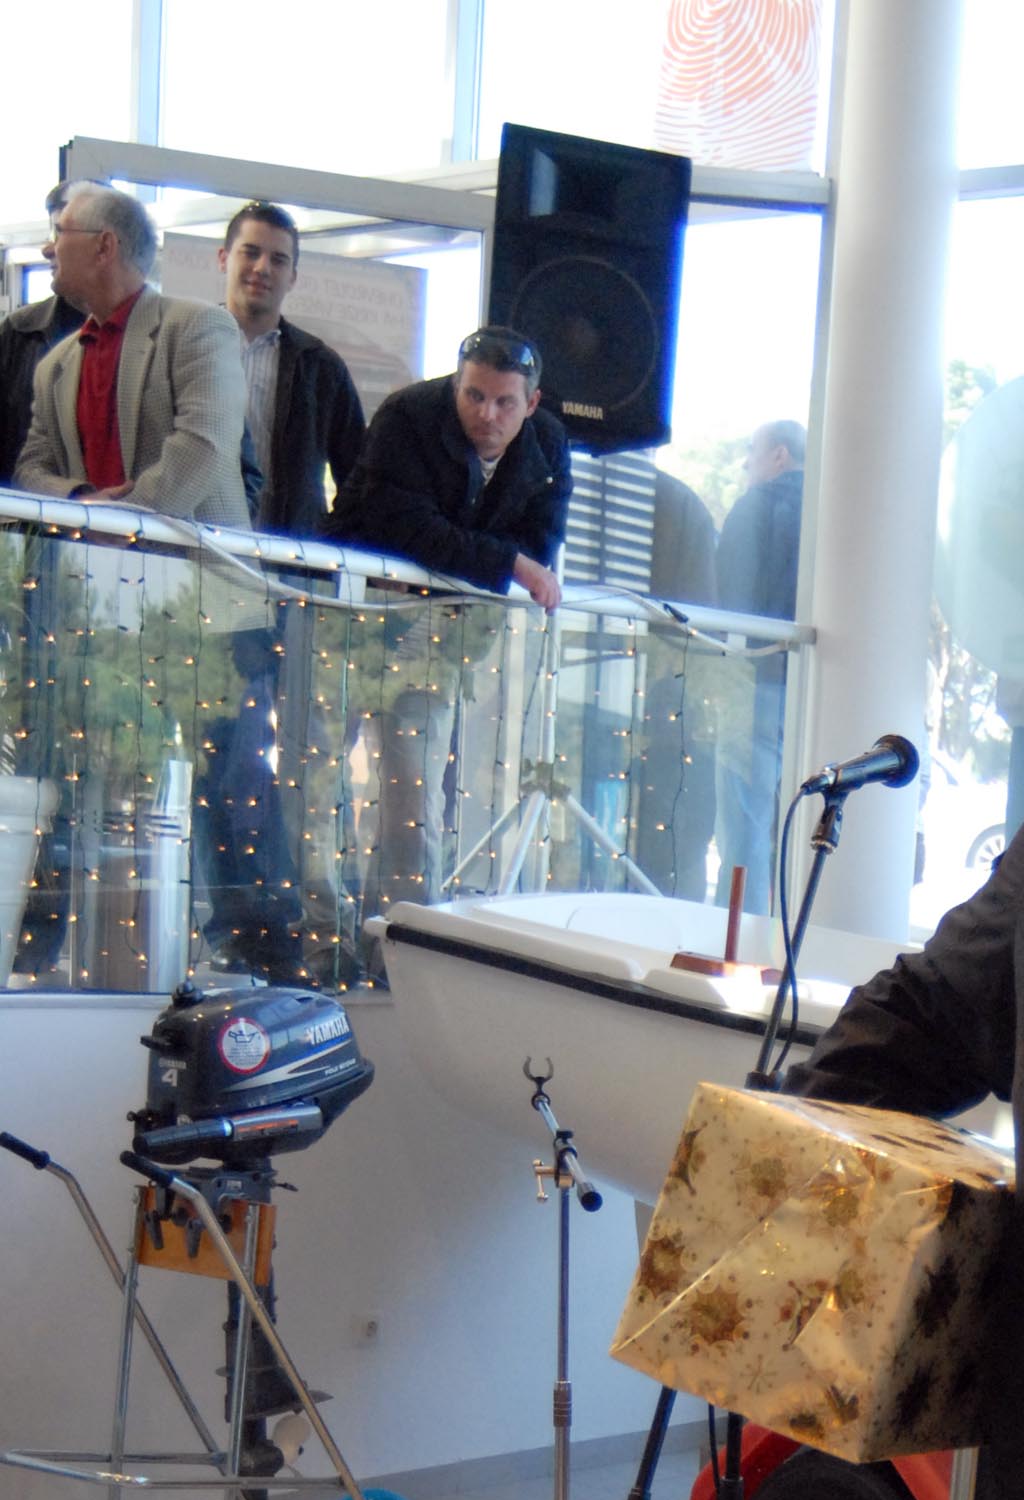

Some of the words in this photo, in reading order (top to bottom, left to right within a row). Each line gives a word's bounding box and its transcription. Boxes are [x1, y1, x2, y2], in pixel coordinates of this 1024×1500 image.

[562, 401, 604, 420] YAMAHA
[307, 1015, 350, 1045] YAMAHA
[161, 1069, 178, 1087] 4
